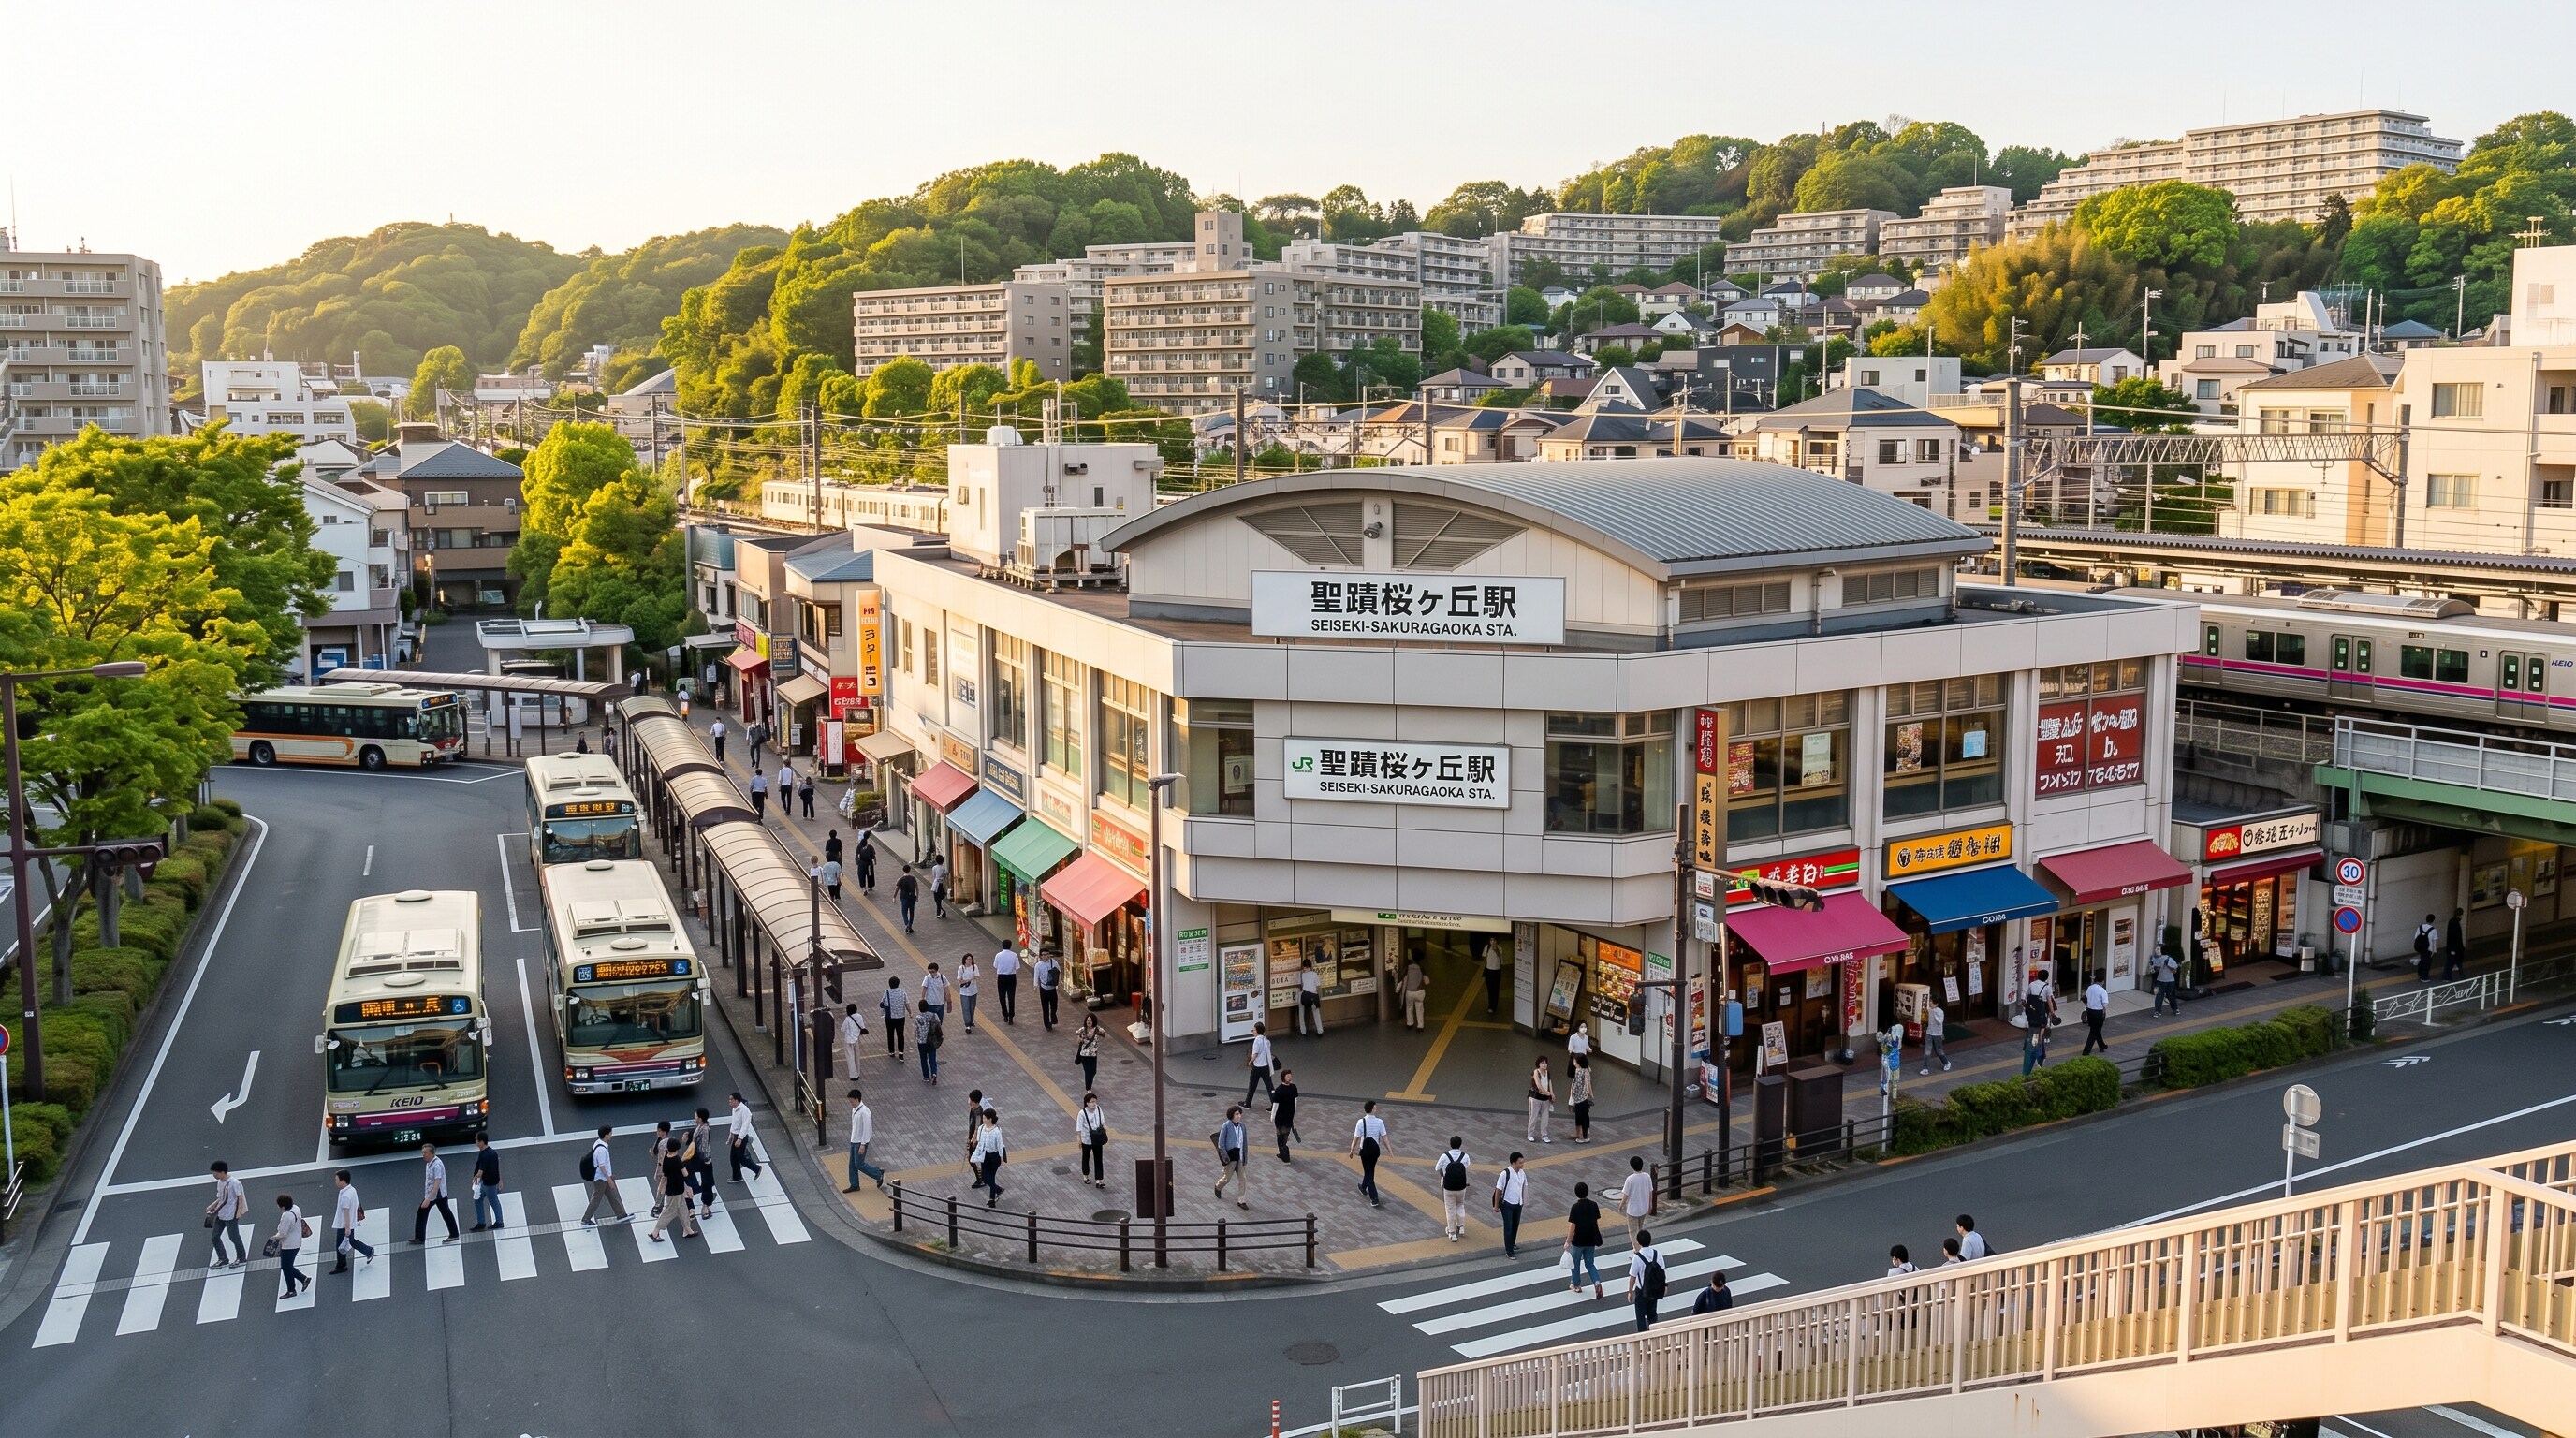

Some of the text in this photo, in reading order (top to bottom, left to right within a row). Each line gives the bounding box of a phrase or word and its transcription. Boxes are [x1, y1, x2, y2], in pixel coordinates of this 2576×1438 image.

[1311, 619, 1517, 637] SEISEKI-SAKURAGAOKA STA.
[1293, 756, 1314, 770] JR
[1319, 781, 1496, 800] SEISEKI-SAKURAGAOKA STA.
[2343, 865, 2360, 879] 30
[390, 1096, 424, 1108] KEIO
